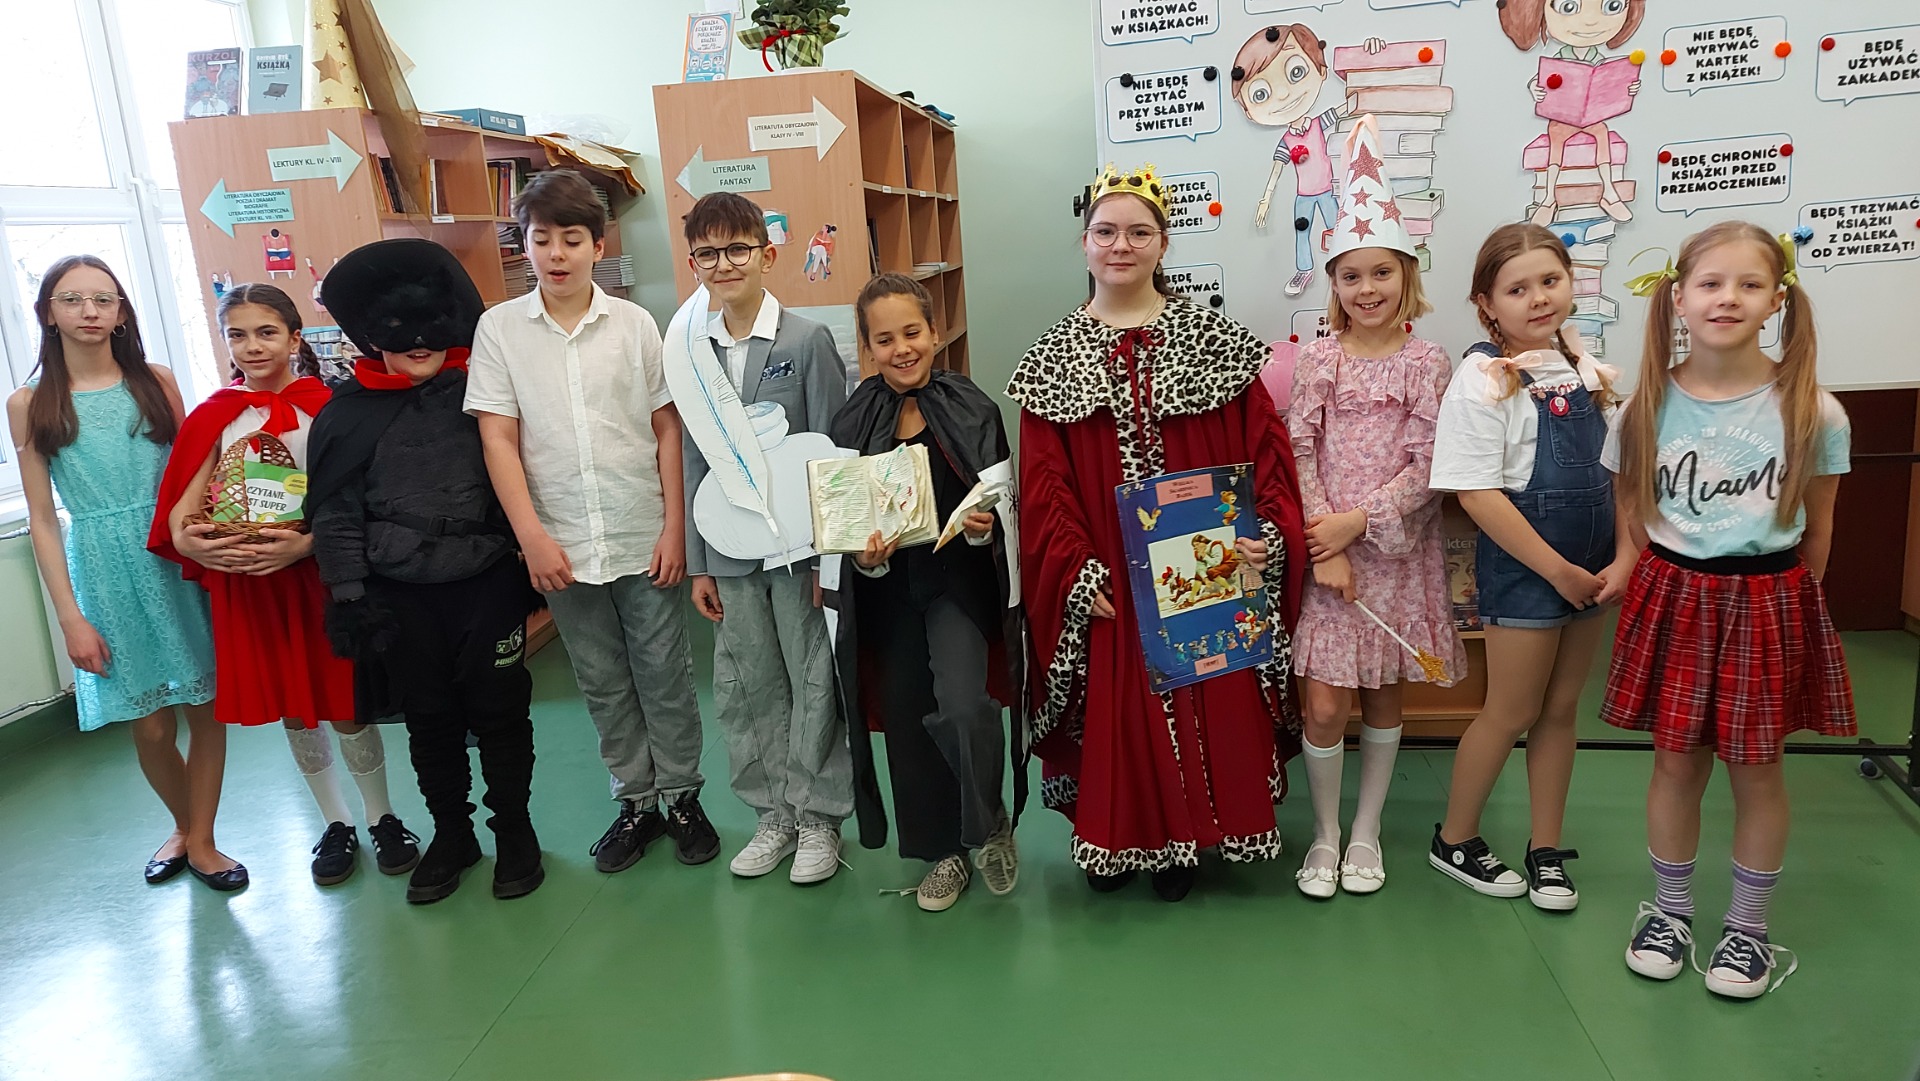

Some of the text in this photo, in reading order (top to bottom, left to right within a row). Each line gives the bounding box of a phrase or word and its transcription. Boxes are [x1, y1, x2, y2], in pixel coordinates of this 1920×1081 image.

[1122, 0, 1198, 20] I RYSOWAĆ
[1111, 15, 1208, 36] W KSIĄŻKACH!
[1694, 26, 1752, 42] NIE BĘDĘ
[1686, 36, 1759, 56] WYRYWAĆ
[1864, 39, 1904, 54] BĘDĘ
[189, 51, 237, 61] KURZOL
[1696, 54, 1748, 68] KARTEK
[1848, 49, 1918, 70] UŻYWAĆ
[256, 60, 290, 70] KSIĄŻKĄ
[1686, 65, 1760, 82] Z KSIĄŻEK!
[1838, 68, 1920, 86] ZAKŁADEK
[1133, 75, 1188, 90] NIE BĘDĘ
[1135, 86, 1186, 104] CZYTAĆ
[1119, 101, 1204, 120] PRZY SŁABYM
[1136, 116, 1192, 132] ŚWIETLE!
[273, 159, 303, 168] LEKTURY
[1672, 145, 1778, 168] BĘDĘ CHRONIĆ
[712, 164, 756, 174] LITERATURA
[1672, 162, 1776, 180] KSIĄŻKI PRZED
[720, 178, 751, 186] FANTASY
[1661, 175, 1786, 195] PRZEMOCZENIEM!
[1811, 196, 1919, 219] BĘDĘ TRZYMAĆ
[1166, 217, 1203, 228] EJSCE!
[1836, 214, 1892, 229] KSIĄŻKI
[1829, 229, 1898, 243] Z DALEKA
[1811, 241, 1915, 258] OD ZWIERZĄT!
[247, 486, 285, 500] CZYTANIE
[248, 498, 287, 511] ST SUPER
